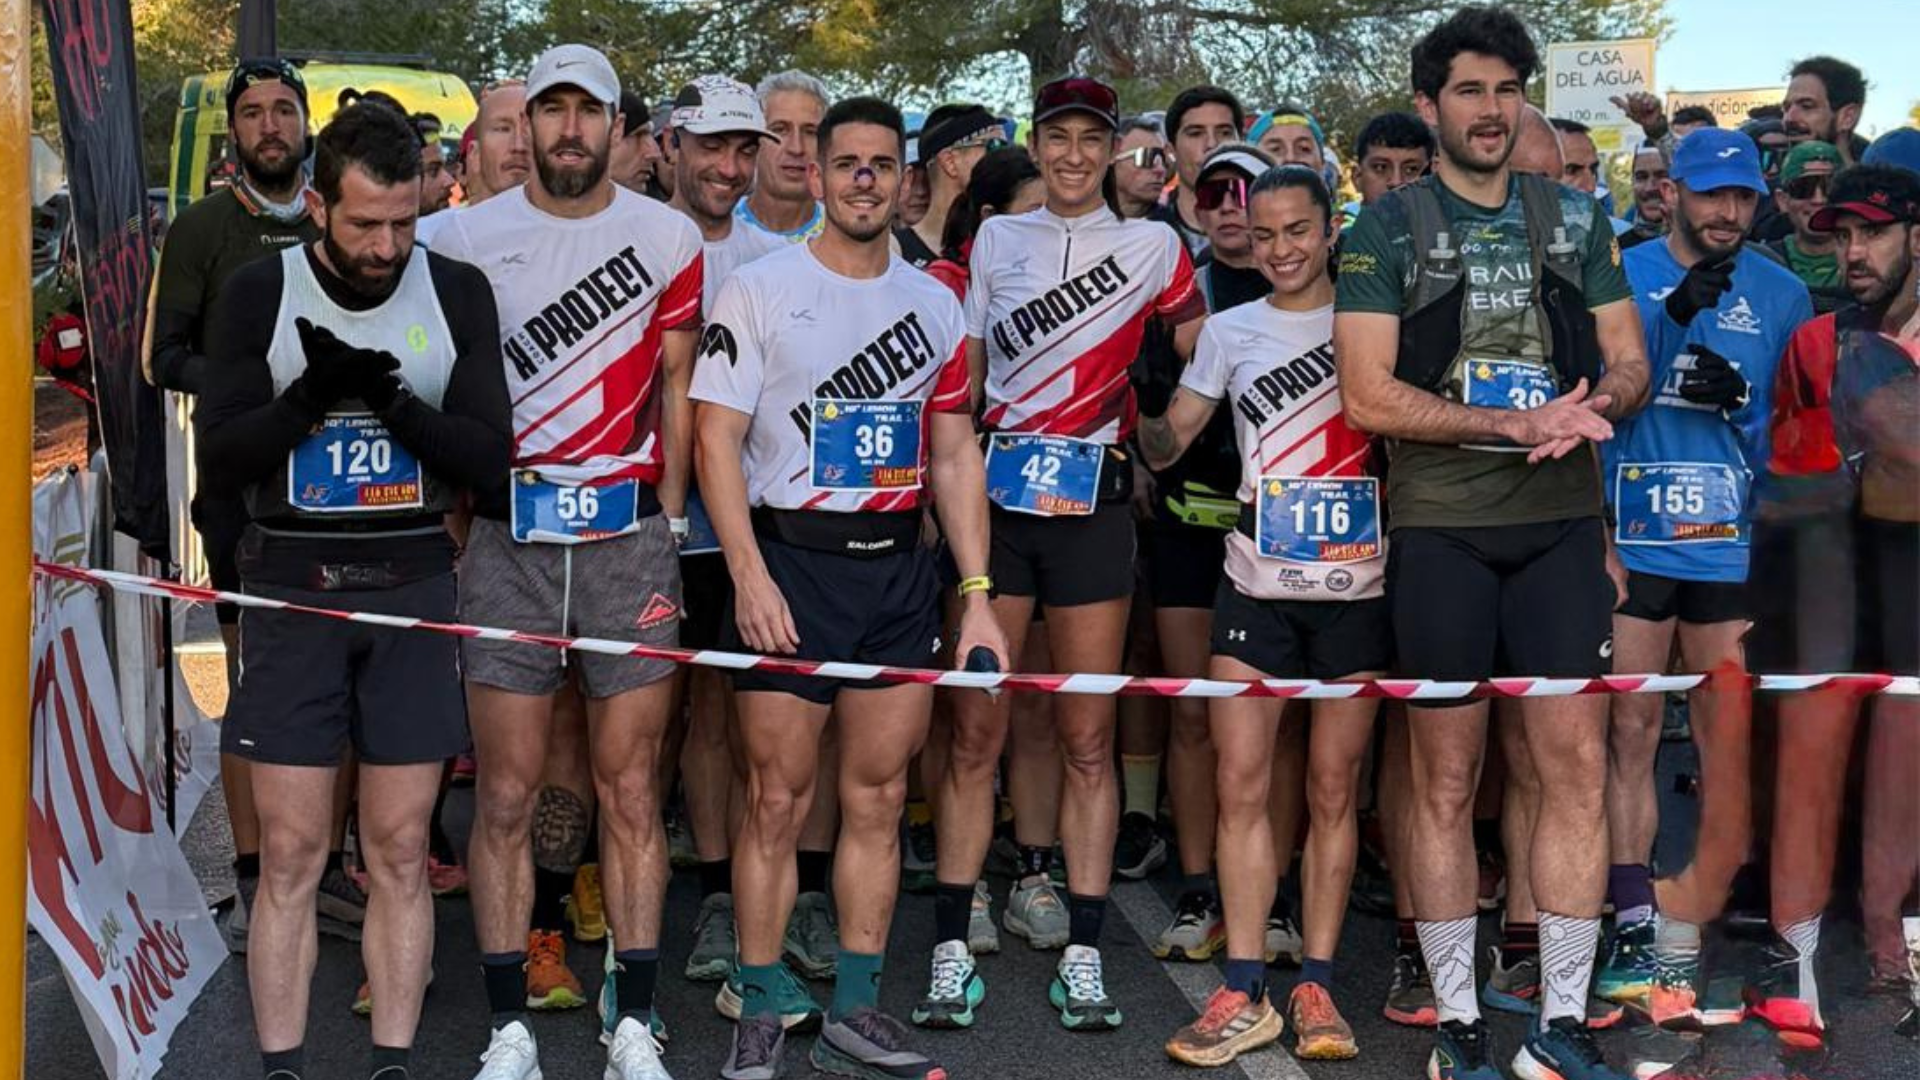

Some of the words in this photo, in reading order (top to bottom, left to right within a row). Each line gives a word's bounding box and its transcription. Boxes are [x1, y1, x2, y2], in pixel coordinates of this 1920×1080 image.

[1577, 50, 1623, 66] CASA
[1556, 72, 1587, 88] DEL
[1593, 69, 1645, 87] AGUA
[523, 245, 653, 362] PROJECT
[1010, 255, 1129, 348] PROJECT
[326, 439, 392, 476] 120
[855, 424, 894, 458] 36
[1021, 454, 1061, 486] 42
[557, 486, 599, 519] 56
[1646, 484, 1705, 514] 155
[1289, 500, 1350, 535] 116
[847, 538, 894, 550] SALOMON
